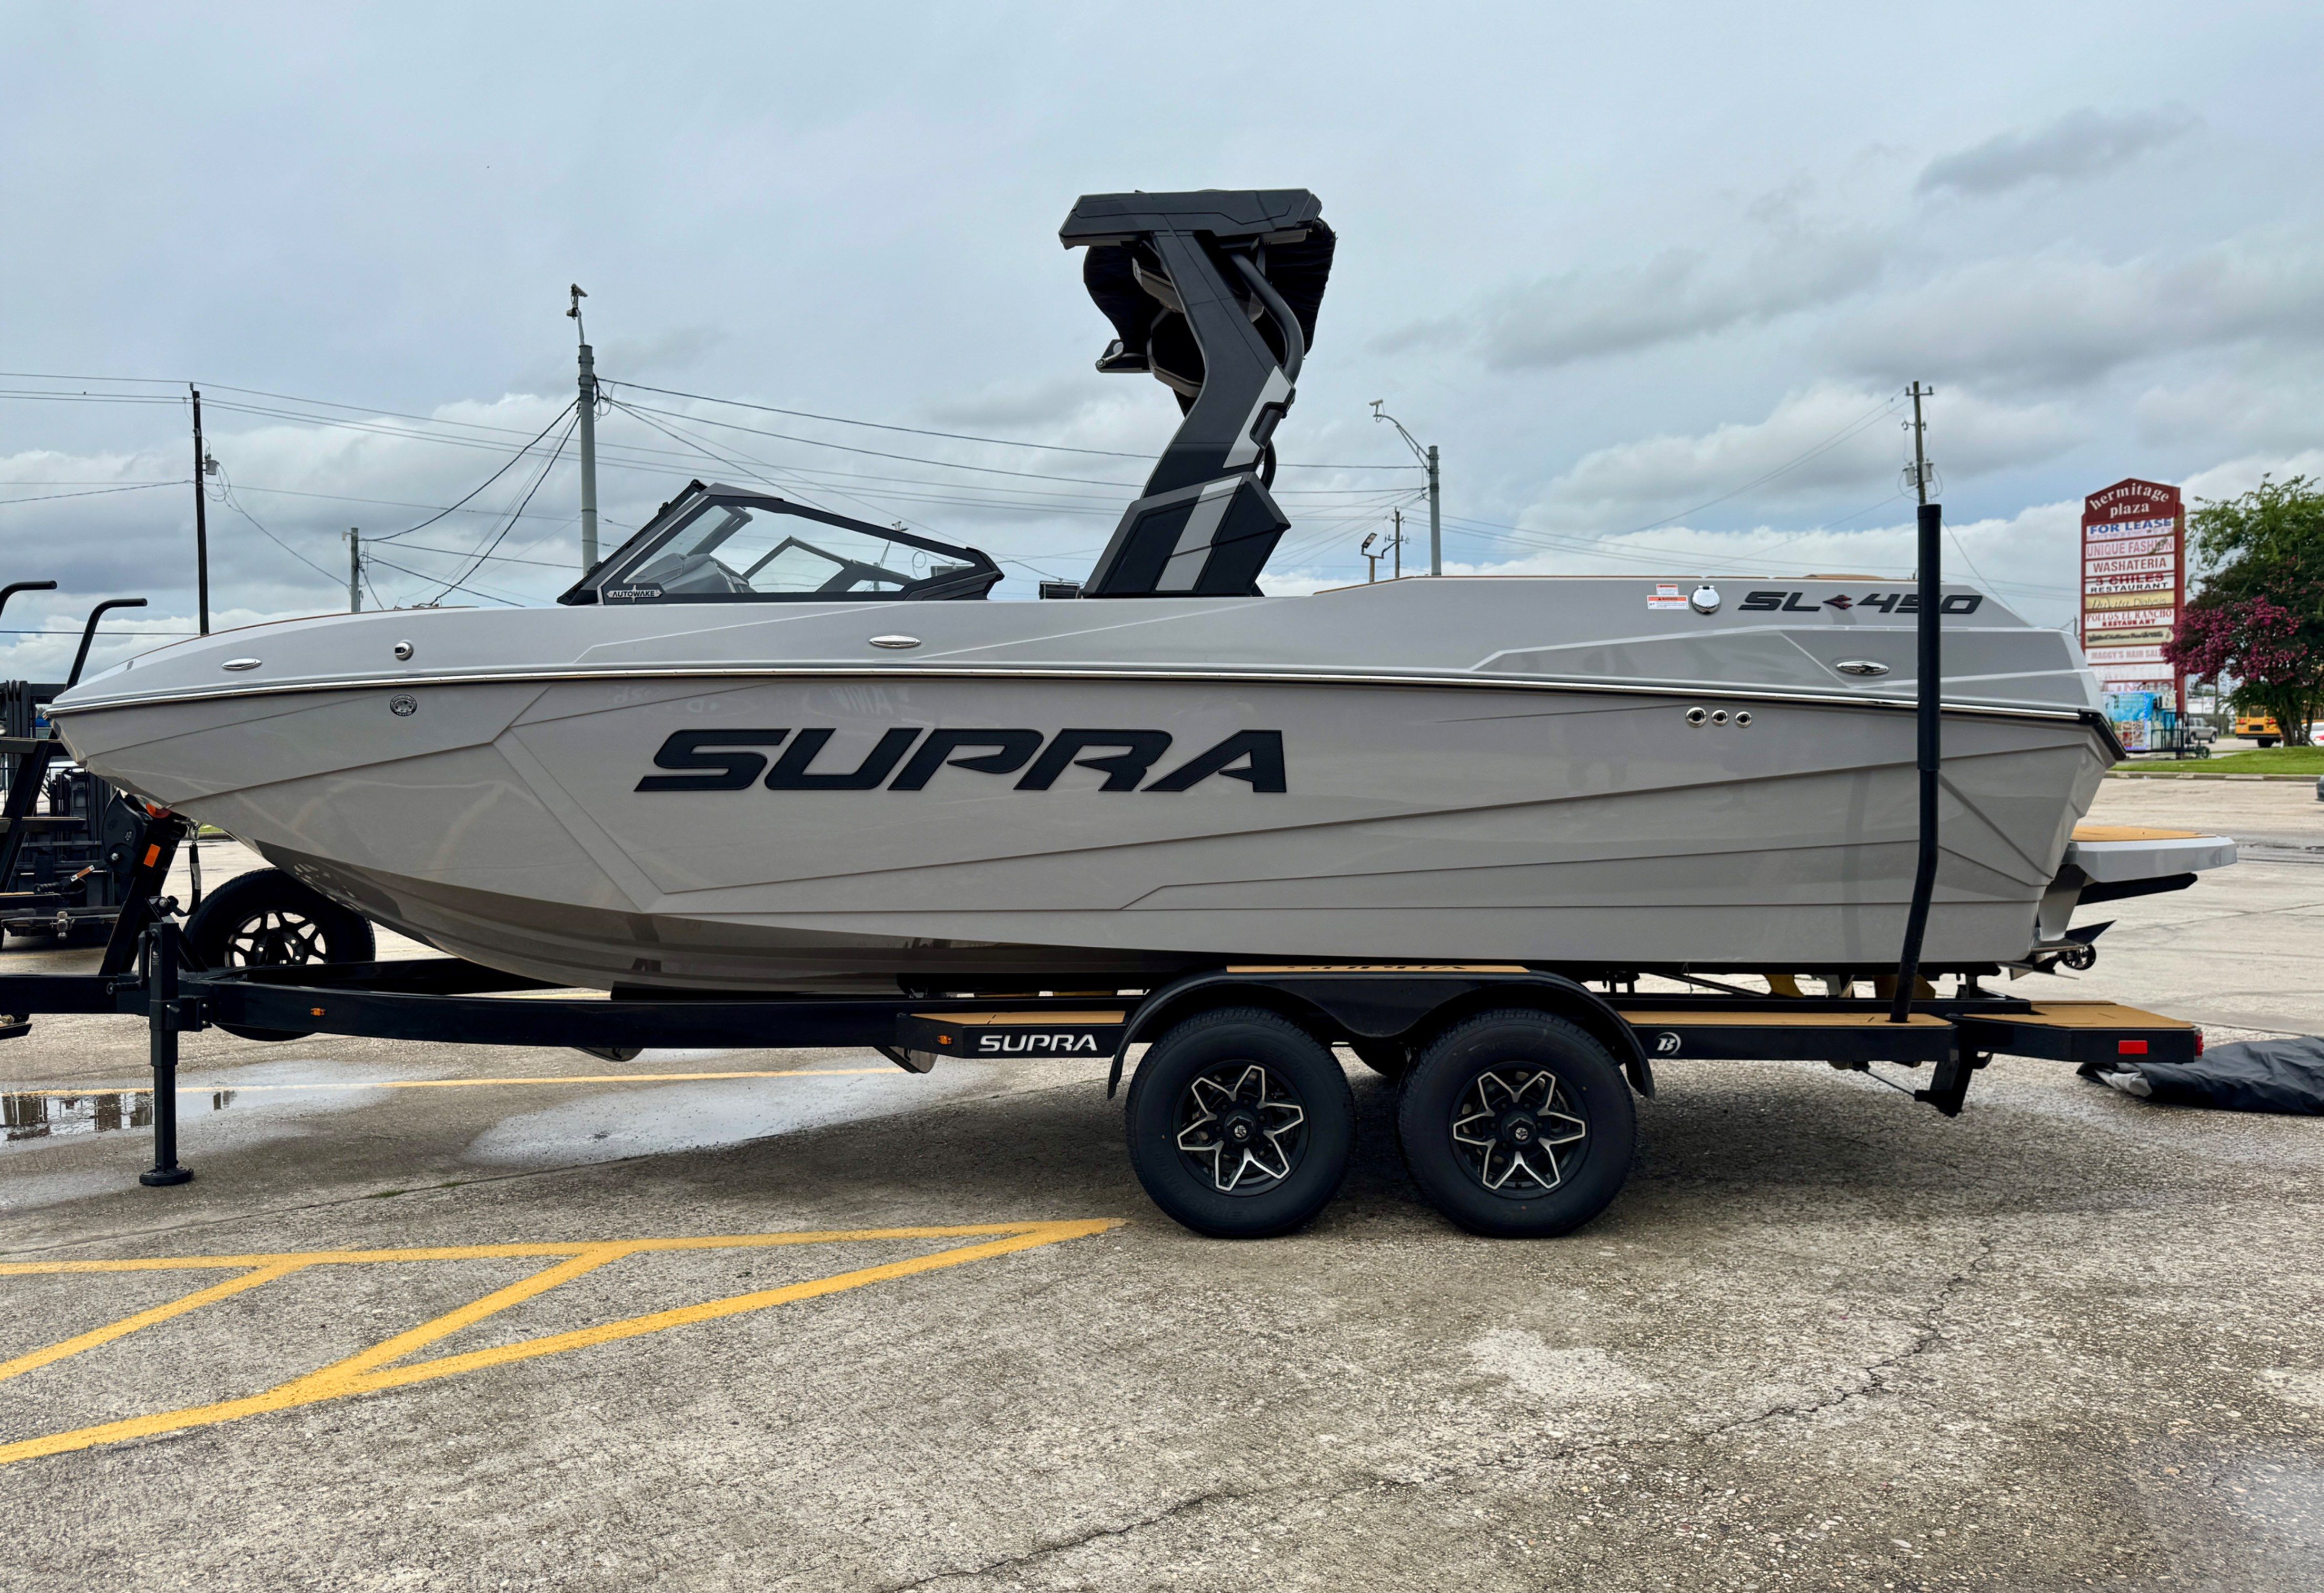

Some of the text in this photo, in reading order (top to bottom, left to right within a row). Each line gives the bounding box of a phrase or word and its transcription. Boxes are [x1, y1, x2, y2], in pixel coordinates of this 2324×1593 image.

[2089, 482, 2169, 510] hermitage
[2110, 503, 2150, 519] plaza
[2090, 524, 2120, 534] FOR
[2125, 518, 2172, 531] LEASE
[2087, 543, 2125, 556] UNIQUE
[2093, 558, 2167, 572] WASHATERIA
[2109, 573, 2164, 585] CHILES
[2091, 582, 2168, 593] RESTAURANT
[1738, 591, 1821, 612] SL
[2087, 609, 2172, 622] POLLOS EL RANCHO
[634, 728, 1287, 792] SUPRA
[978, 1034, 1098, 1051] SUPRA
